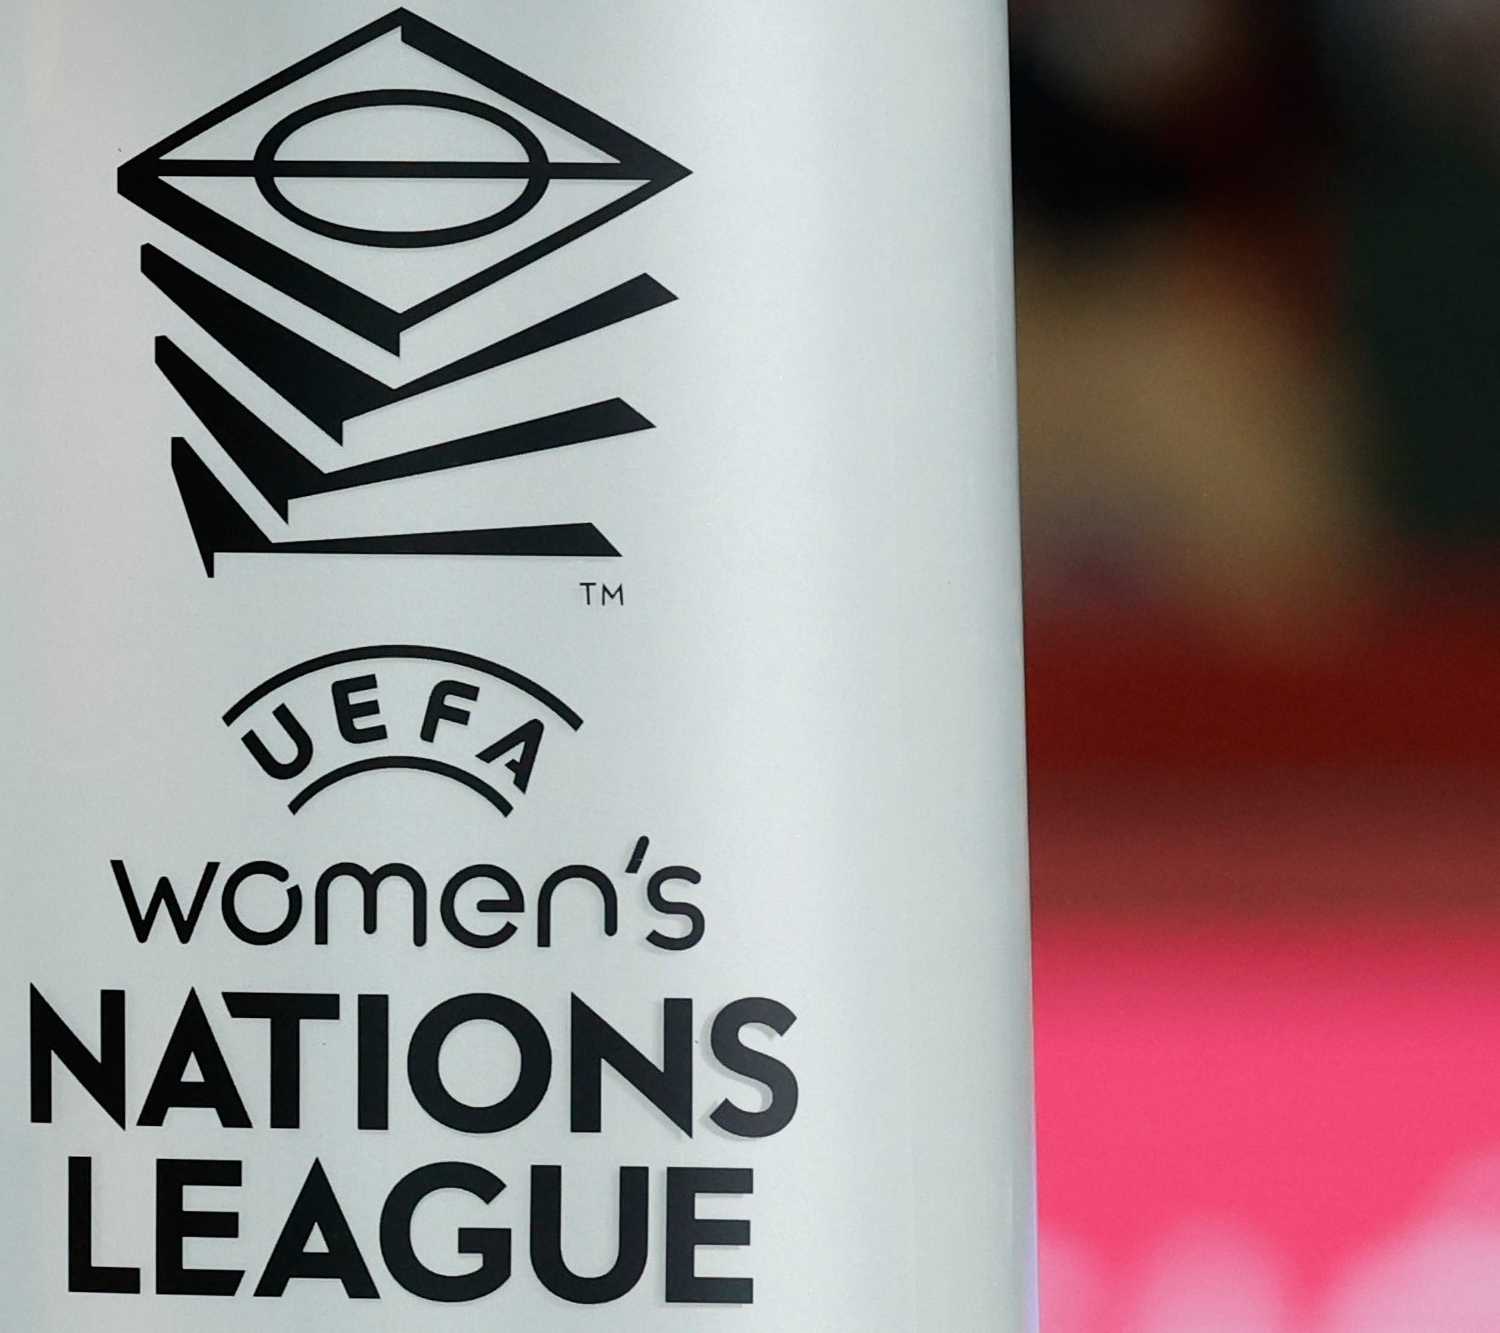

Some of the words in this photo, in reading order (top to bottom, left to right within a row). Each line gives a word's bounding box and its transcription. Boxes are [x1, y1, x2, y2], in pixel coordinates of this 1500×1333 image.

[580, 582, 625, 606] TM
[241, 673, 545, 794] UEFA
[110, 835, 705, 951] women's
[30, 982, 799, 1139] NATIONS
[68, 1157, 754, 1305] LEAGUE
